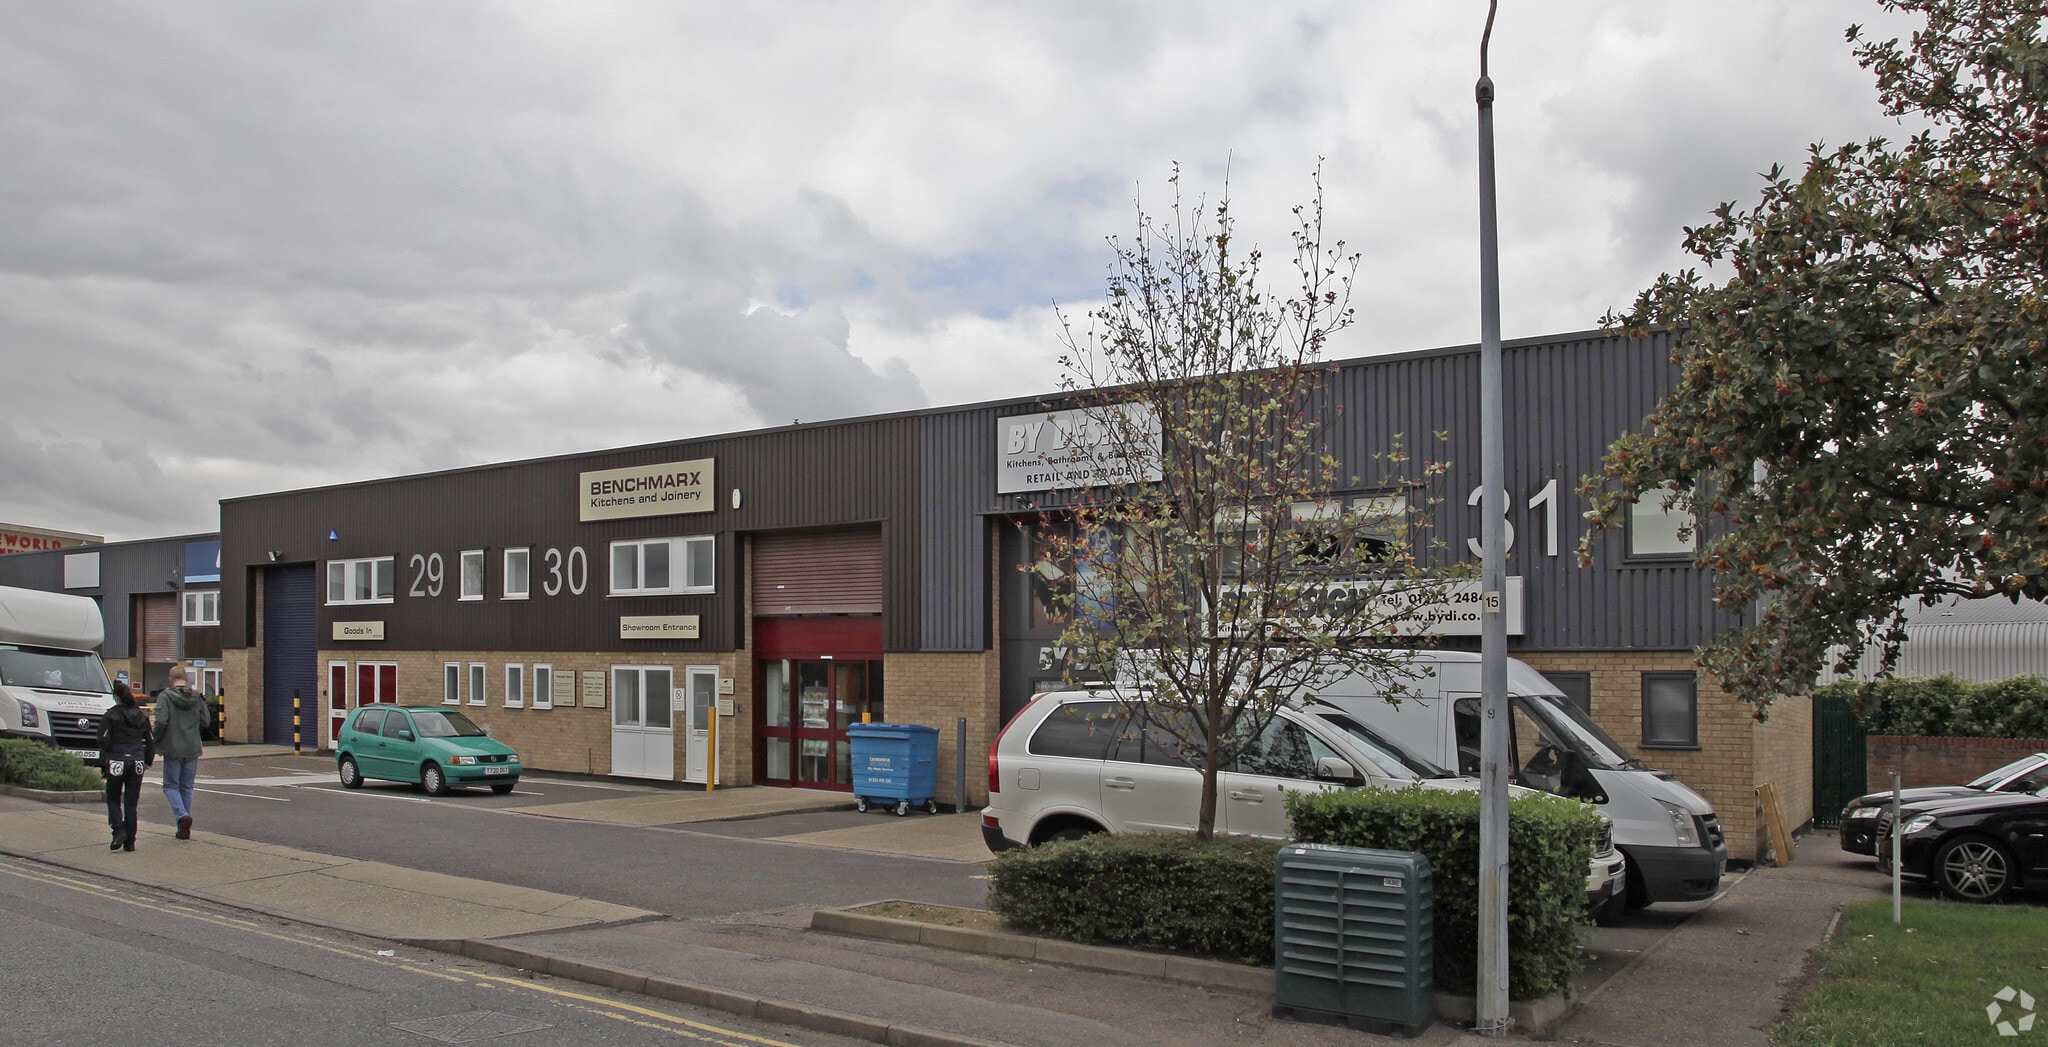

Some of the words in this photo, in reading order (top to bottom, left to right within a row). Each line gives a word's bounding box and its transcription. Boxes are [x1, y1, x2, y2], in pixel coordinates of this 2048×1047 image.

[1008, 422, 1044, 455] BY
[1007, 460, 1044, 469] Kitchens,
[591, 471, 701, 495] BENCHMARX
[1027, 474, 1061, 483] RETAIL
[1066, 470, 1090, 479] AND
[1096, 467, 1132, 477] RADE
[591, 496, 635, 507] Kitchens
[638, 493, 657, 503] and
[661, 491, 701, 502] Joinery
[0, 533, 62, 550] WORLD
[409, 553, 444, 597] 29
[543, 546, 588, 596] 30
[1485, 596, 1499, 607] 15
[344, 627, 364, 635] Goods
[366, 627, 373, 635] In
